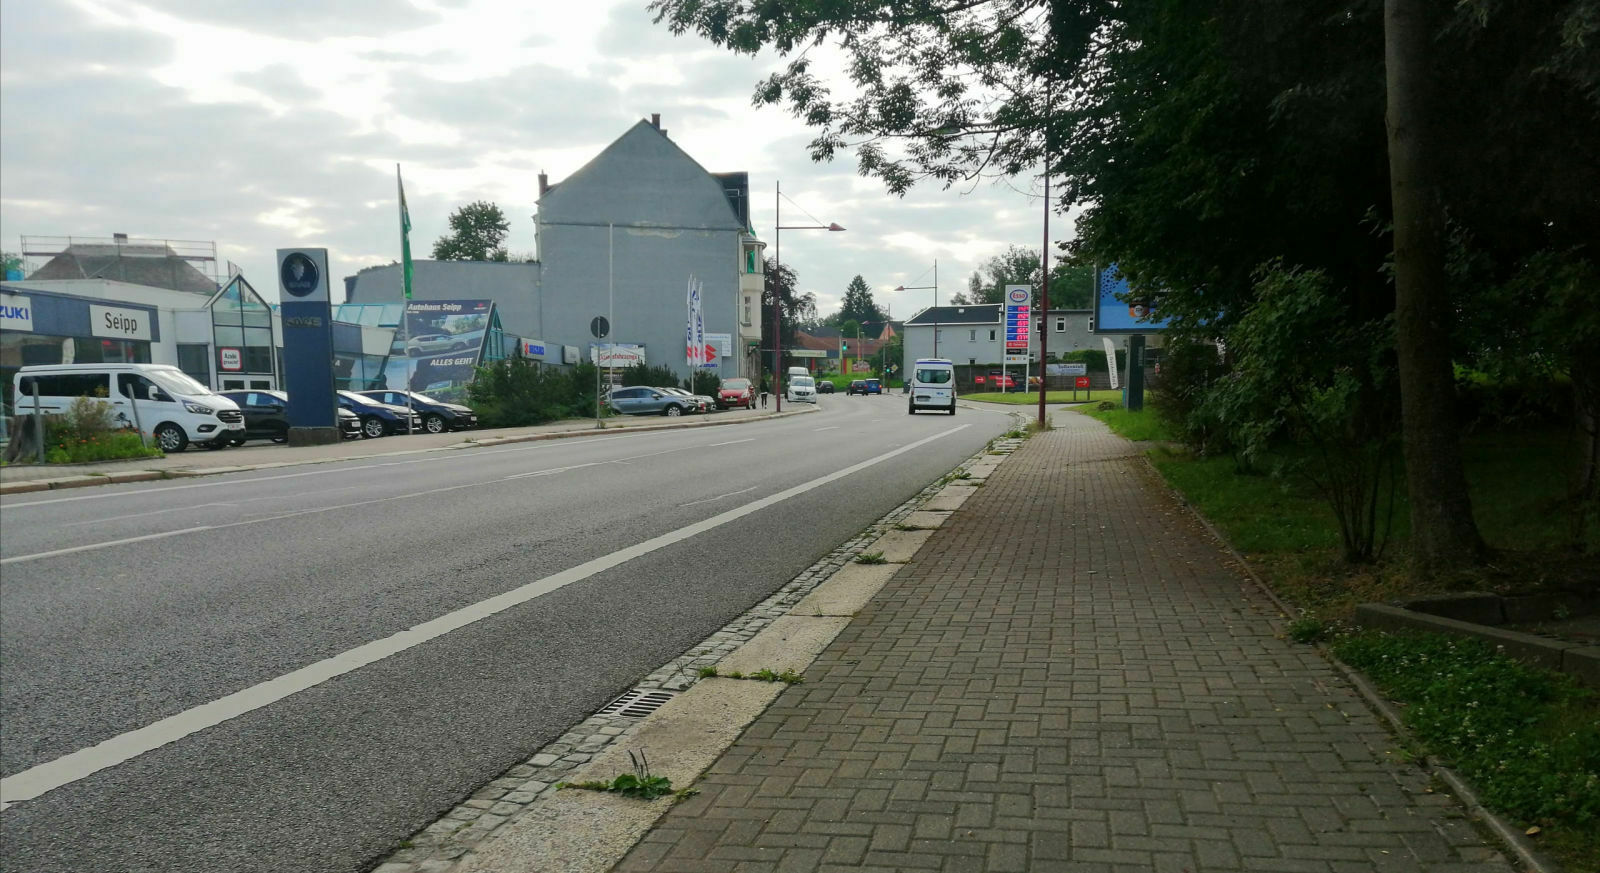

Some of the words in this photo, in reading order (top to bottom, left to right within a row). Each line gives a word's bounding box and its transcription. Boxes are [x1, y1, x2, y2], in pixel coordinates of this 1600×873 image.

[408, 303, 441, 311] Autohaus
[441, 303, 462, 312] Seipp
[105, 312, 137, 334] Seipp
[430, 358, 454, 366] ALLES
